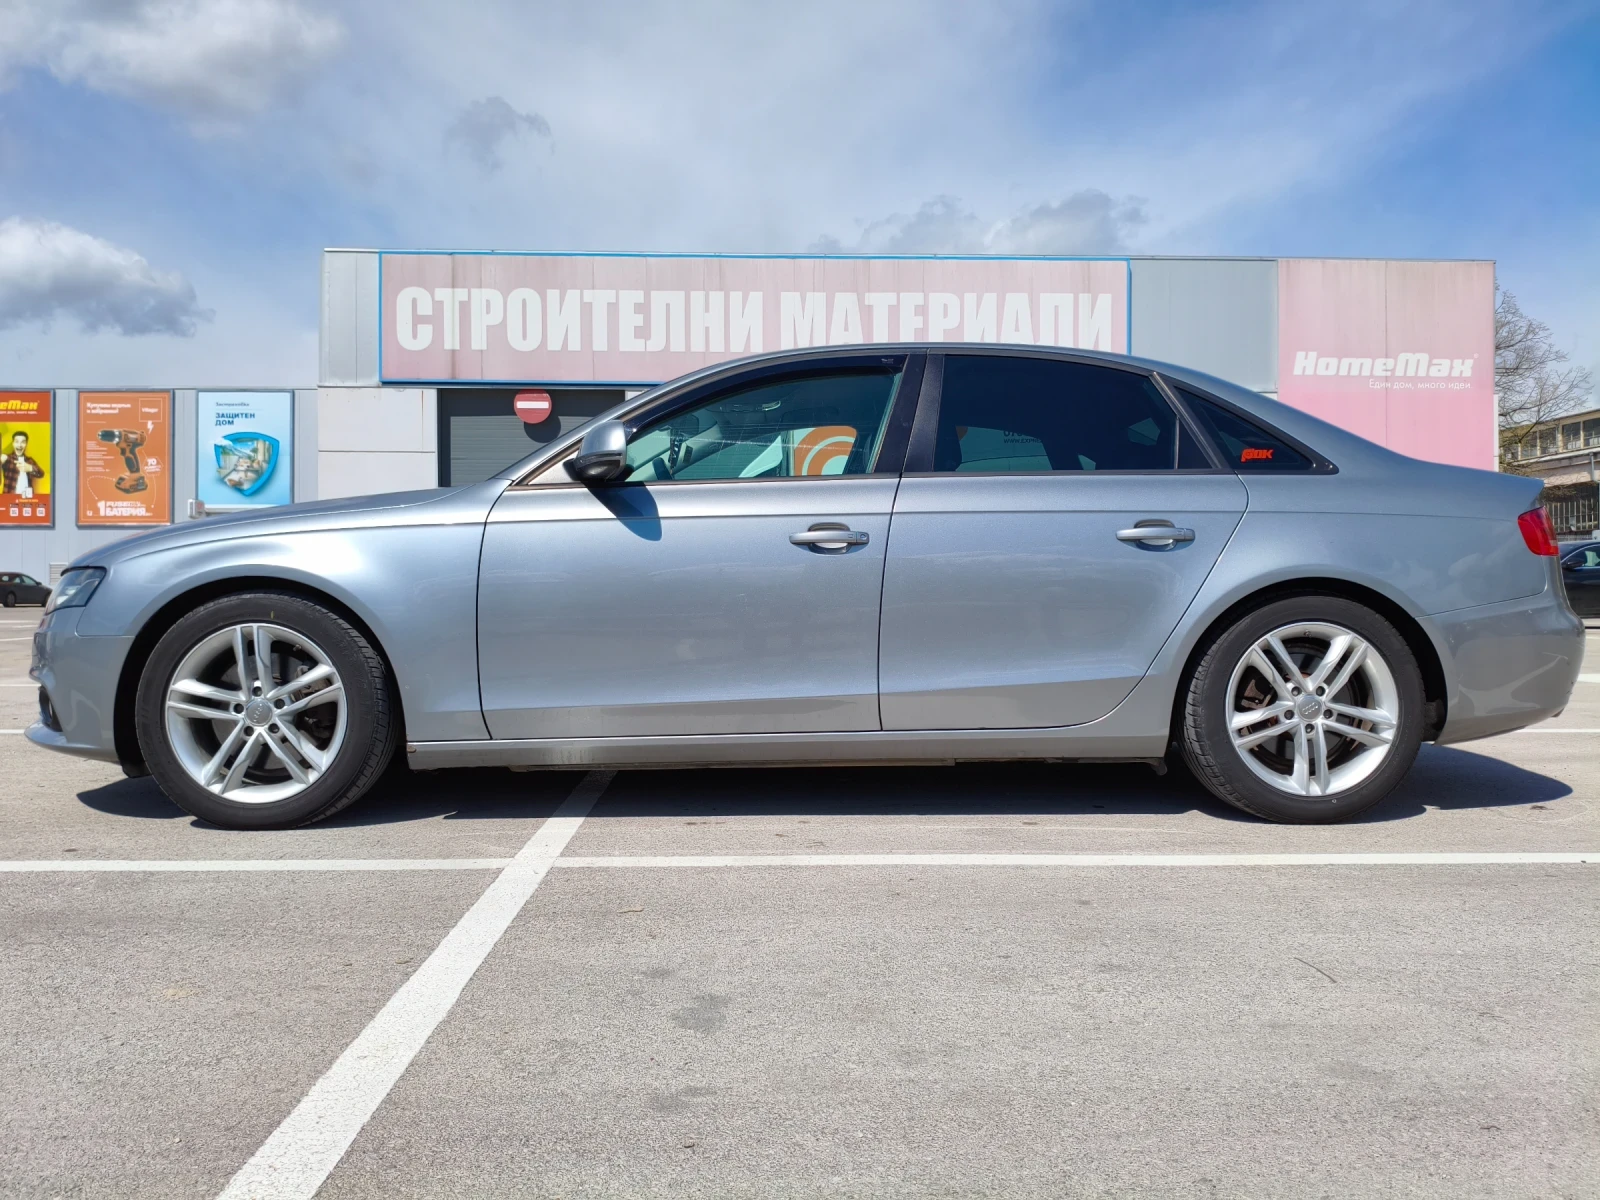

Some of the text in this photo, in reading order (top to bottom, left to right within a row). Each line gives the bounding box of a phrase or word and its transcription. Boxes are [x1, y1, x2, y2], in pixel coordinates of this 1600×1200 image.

[396, 286, 763, 353] СТРОИТЕЛНИ
[1369, 379, 1391, 389] Един
[1393, 382, 1415, 390] дом,
[215, 412, 256, 420] ЗАЩИТЕН
[215, 419, 235, 427] ДОМ
